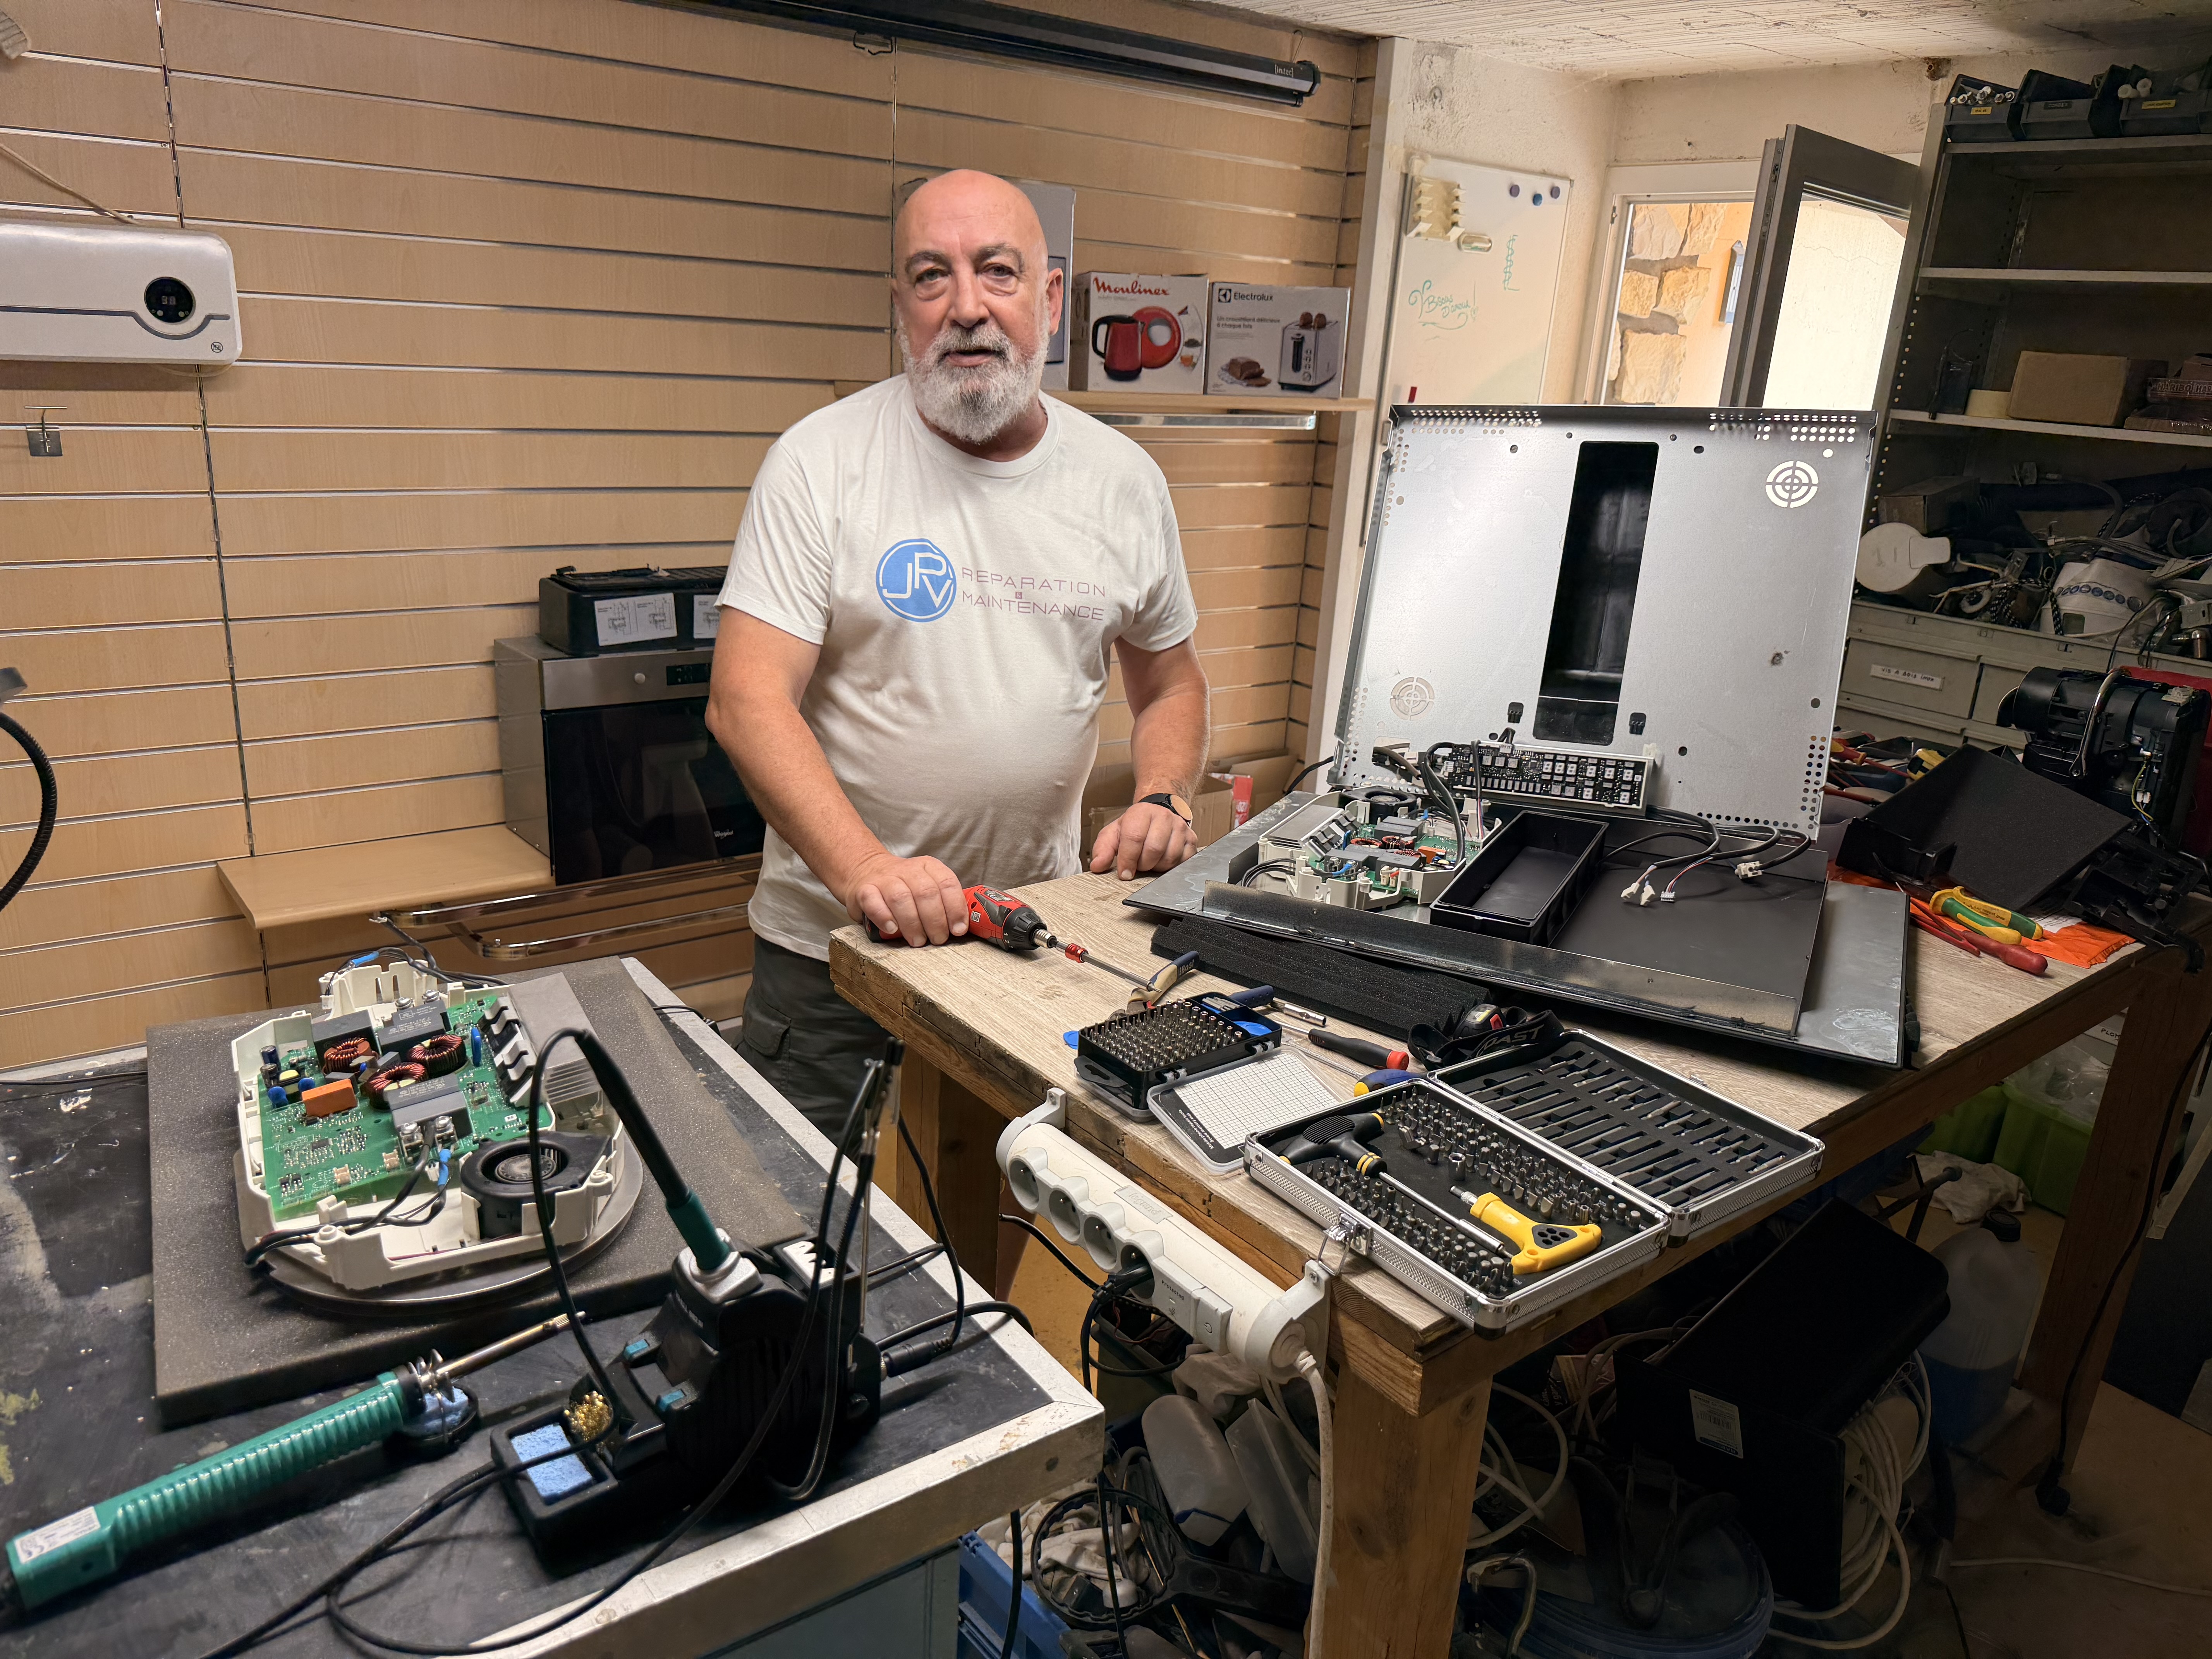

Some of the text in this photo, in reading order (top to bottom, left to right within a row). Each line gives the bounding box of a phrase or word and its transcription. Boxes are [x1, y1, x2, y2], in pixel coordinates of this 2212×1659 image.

[1093, 276, 1170, 295] Moulinex
[1234, 292, 1273, 301] Electrolux
[2157, 380, 2193, 392] HARIBO
[962, 567, 1105, 597] REPARATION
[962, 591, 1104, 621] MAINTENANCE
[1185, 1118, 1195, 1128] repair
[1192, 1120, 1205, 1132] memory
[1194, 1128, 1205, 1138] phone
[1204, 1133, 1214, 1142] Screw
[1203, 1138, 1214, 1149] Mobile
[1128, 1191, 1162, 1217] legrand
